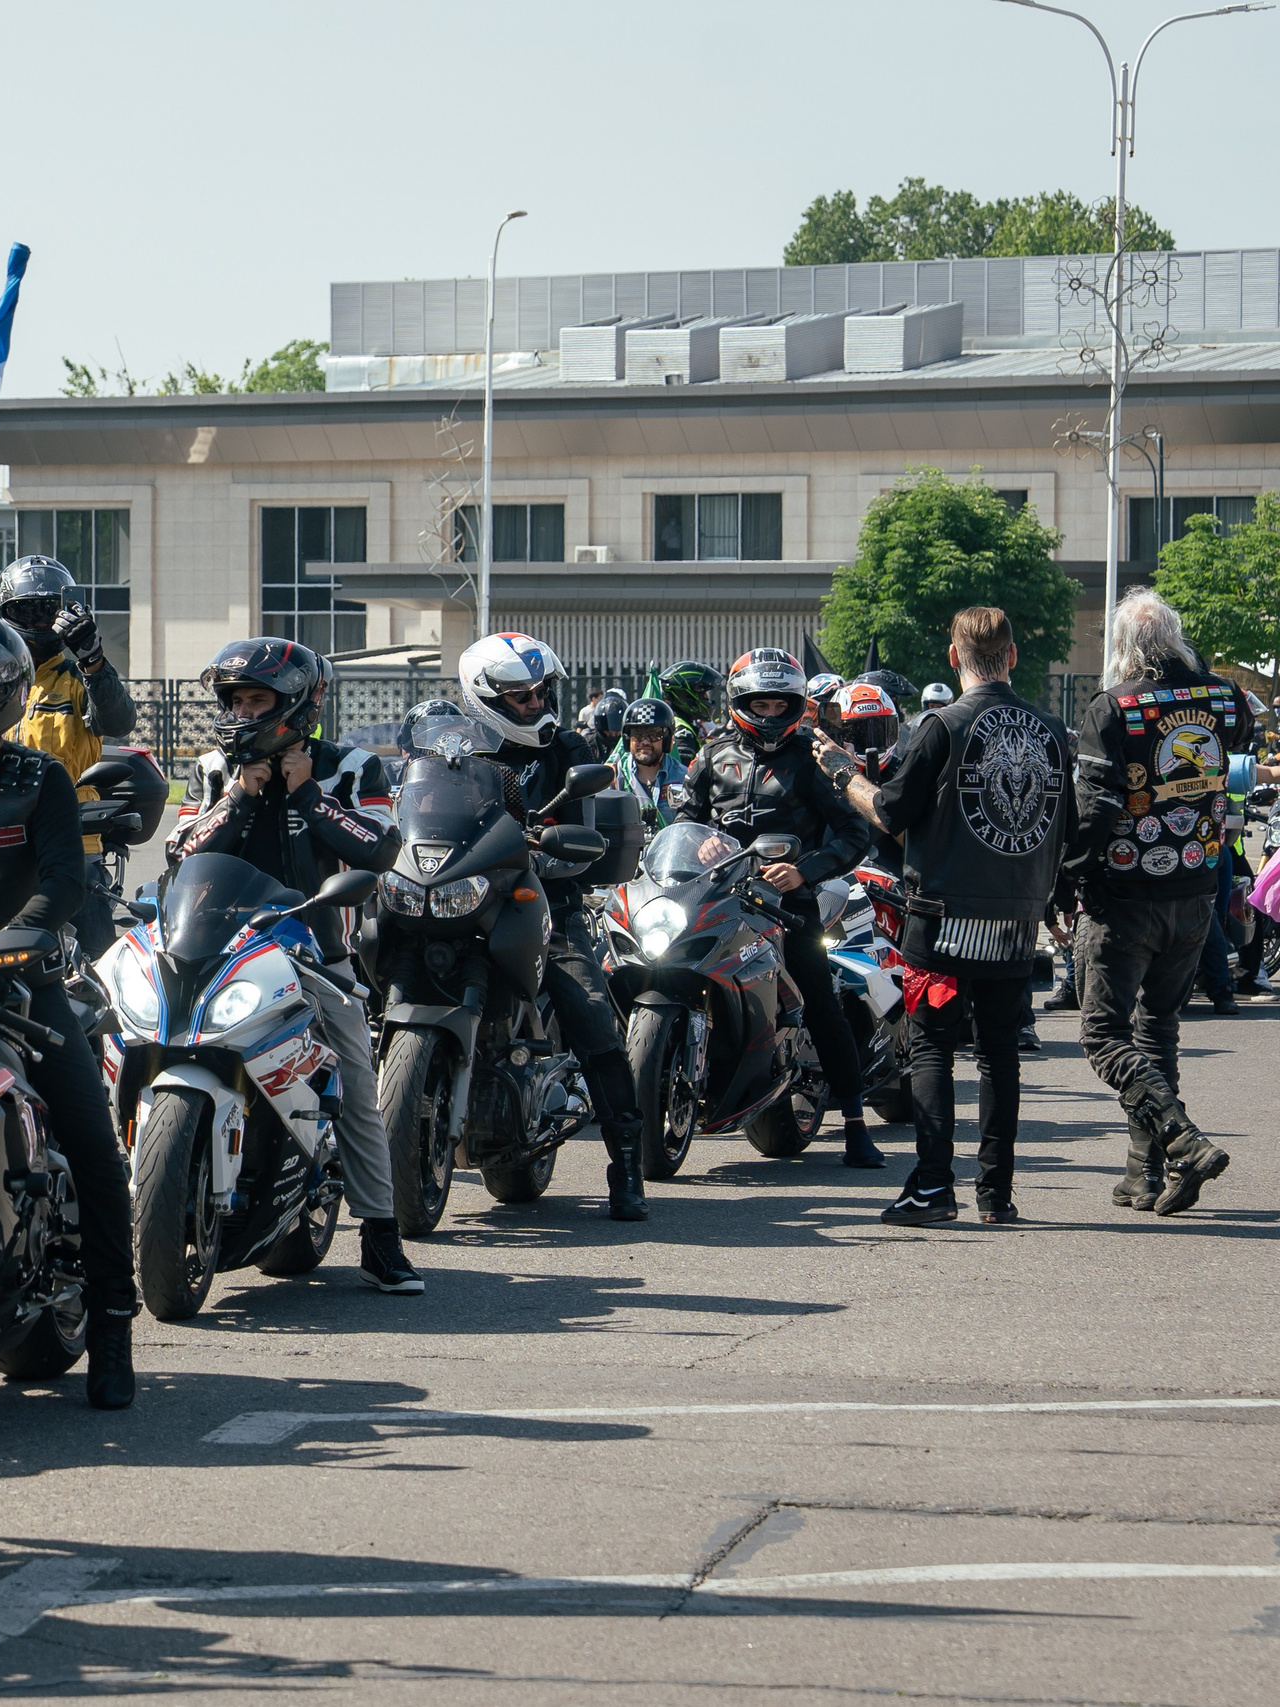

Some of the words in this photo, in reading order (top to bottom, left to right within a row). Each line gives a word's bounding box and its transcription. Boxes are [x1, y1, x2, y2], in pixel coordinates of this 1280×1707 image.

[857, 704, 878, 713] SHOEI
[974, 708, 1052, 745] ДЮЖИНА
[1157, 708, 1218, 736] ENDURO
[964, 773, 979, 783] XII
[1176, 779, 1209, 794] UZBEKISTAN
[315, 802, 378, 843] SWEEP
[968, 806, 1051, 852] ТАШКЕНТ
[272, 981, 296, 1000] RR
